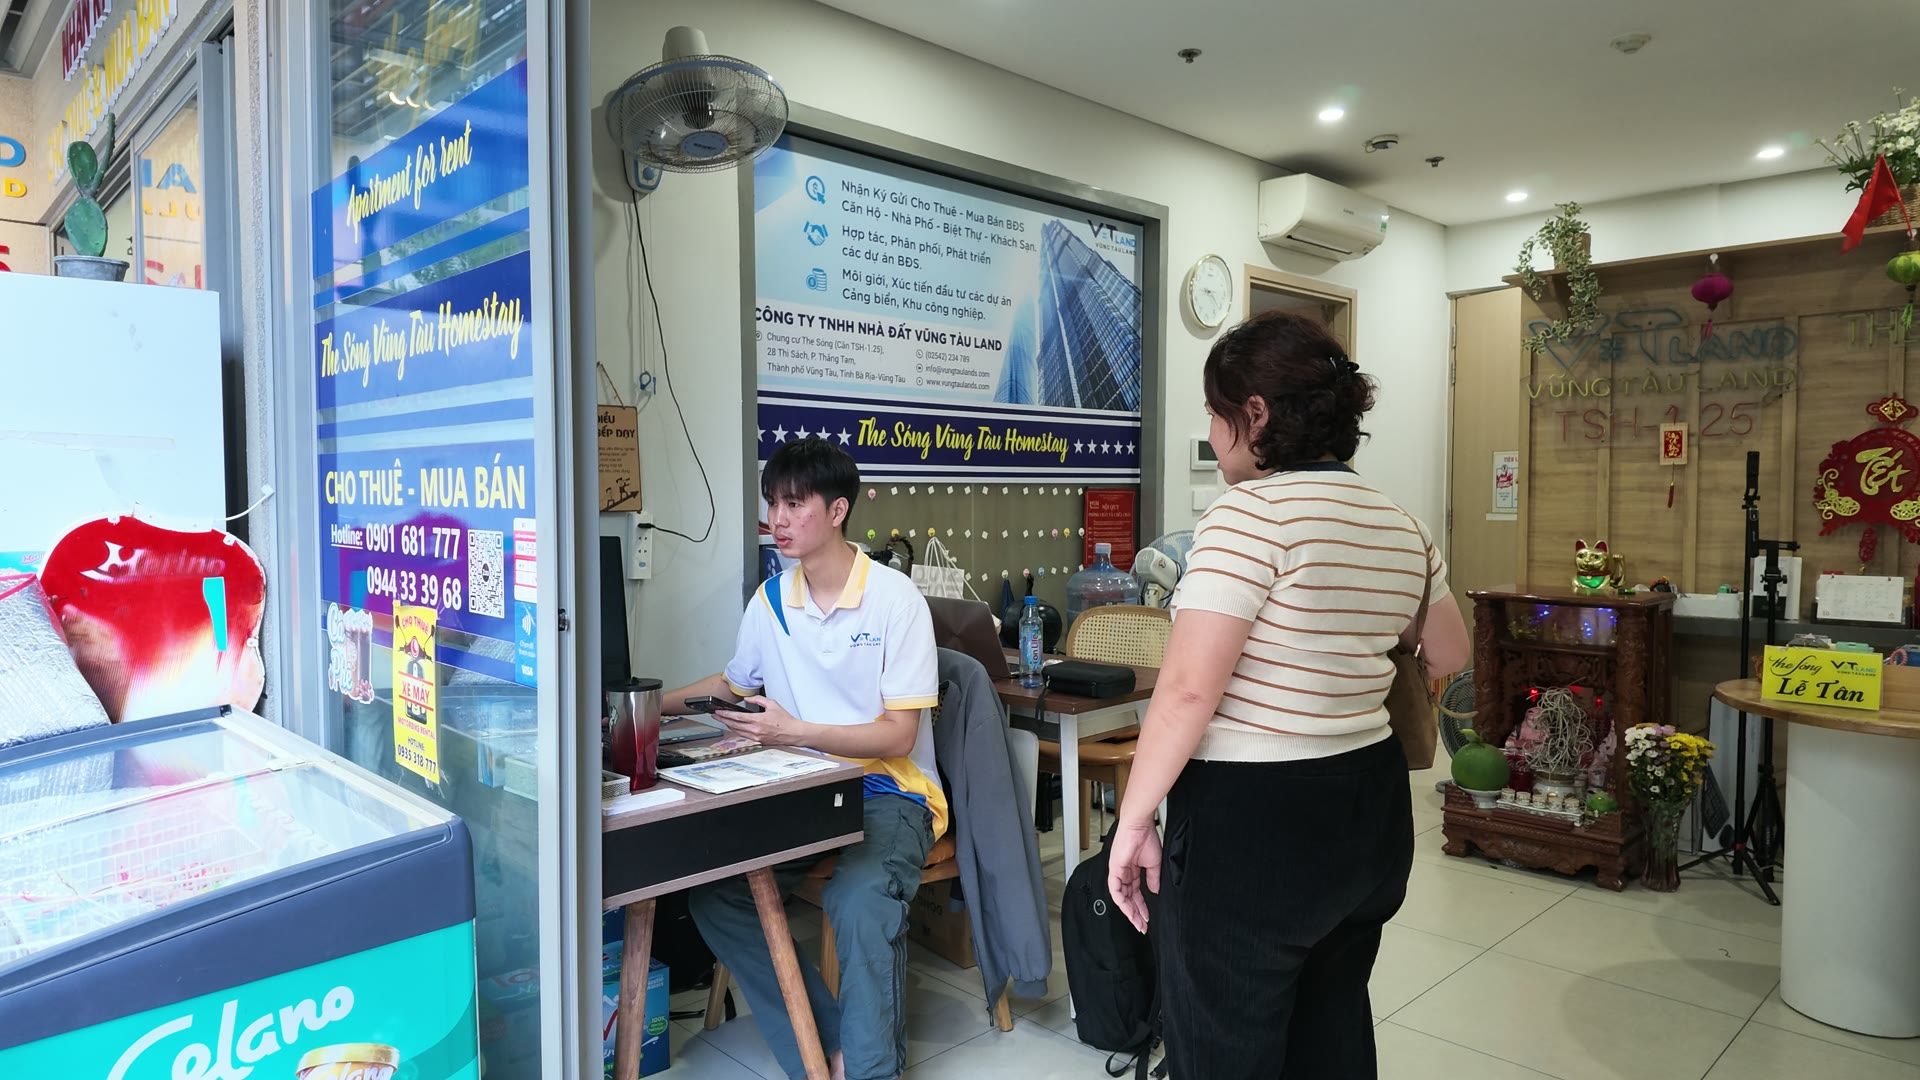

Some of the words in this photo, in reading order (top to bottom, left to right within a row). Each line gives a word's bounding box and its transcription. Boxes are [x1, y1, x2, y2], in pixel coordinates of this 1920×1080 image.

[347, 154, 413, 244] Apartment
[413, 142, 436, 210] for
[439, 119, 472, 178] rent
[841, 179, 869, 198] Nhận
[873, 187, 887, 202] Ký
[890, 192, 908, 206] Gửi
[911, 196, 930, 211] Cho
[934, 201, 957, 217] Thuê
[965, 209, 985, 224] Mua
[987, 213, 1004, 228] Bán
[1006, 219, 1025, 233] BĐS
[841, 200, 863, 215] Căn
[866, 205, 881, 220] Hộ
[891, 210, 912, 226] Nhà
[914, 214, 934, 230] Phố
[943, 222, 962, 238] Biệt
[965, 226, 982, 241] Thự
[991, 232, 1018, 248] Khách
[842, 226, 865, 241] Hợp
[868, 230, 888, 246] tác,
[891, 234, 916, 251] Phân
[919, 240, 944, 257] phối,
[946, 246, 968, 262] Phát
[970, 249, 992, 265] triển
[842, 246, 861, 259] các
[865, 248, 879, 263] dự
[881, 252, 895, 265] án
[897, 255, 922, 270] BĐS.
[842, 269, 862, 283] Môi
[865, 272, 888, 288] giới,
[891, 277, 911, 291] Xúc
[914, 281, 933, 295] tiến
[955, 288, 966, 301] tư
[968, 290, 985, 303] các
[987, 293, 1000, 307] dự
[1001, 295, 1012, 307] án
[842, 287, 871, 305] Cảng
[874, 291, 900, 309] biển,
[902, 297, 922, 311] Khu
[925, 299, 949, 317] công
[952, 305, 986, 321] nghiệp.
[321, 331, 340, 378] The
[341, 331, 371, 388] Sóng
[373, 318, 407, 381] Vũng
[409, 309, 434, 358] Tàu
[438, 291, 524, 360] Homestay
[755, 305, 794, 326] CÔNG
[798, 313, 814, 327] TY
[818, 316, 855, 333] TNHH
[858, 320, 885, 337] NHÀ
[888, 323, 912, 340] ĐẤT
[915, 327, 947, 345] VŨNG
[950, 332, 972, 348] TÀU
[974, 337, 1002, 351] LAND
[767, 332, 790, 344] Chung
[801, 336, 815, 346] The
[767, 347, 776, 356] 28
[791, 363, 805, 375] phố
[1527, 373, 1611, 399] VŨNG
[1696, 367, 1796, 393] LAND
[857, 416, 887, 448] The
[891, 424, 932, 460] Sóng
[935, 423, 974, 462] Vũng
[977, 425, 1002, 452] Tàu
[1005, 427, 1070, 464] Homestay
[325, 469, 356, 505] CHO
[359, 458, 404, 506] THUÊ
[420, 467, 465, 508] MUA
[475, 453, 526, 510] BÁN
[331, 523, 363, 547] Hotline:
[366, 522, 395, 553] 0901
[401, 525, 426, 557] 681
[432, 527, 460, 560] 777
[366, 565, 397, 598] 0944
[400, 570, 417, 602] 33
[420, 573, 439, 606] 39
[442, 576, 462, 611] 68
[402, 681, 411, 695] XE
[414, 682, 430, 704] MÁY
[1776, 677, 1809, 697] Lễ
[1816, 679, 1865, 703] Tân
[397, 743, 412, 761] 0935
[413, 751, 424, 767] 318
[425, 757, 437, 774] 777
